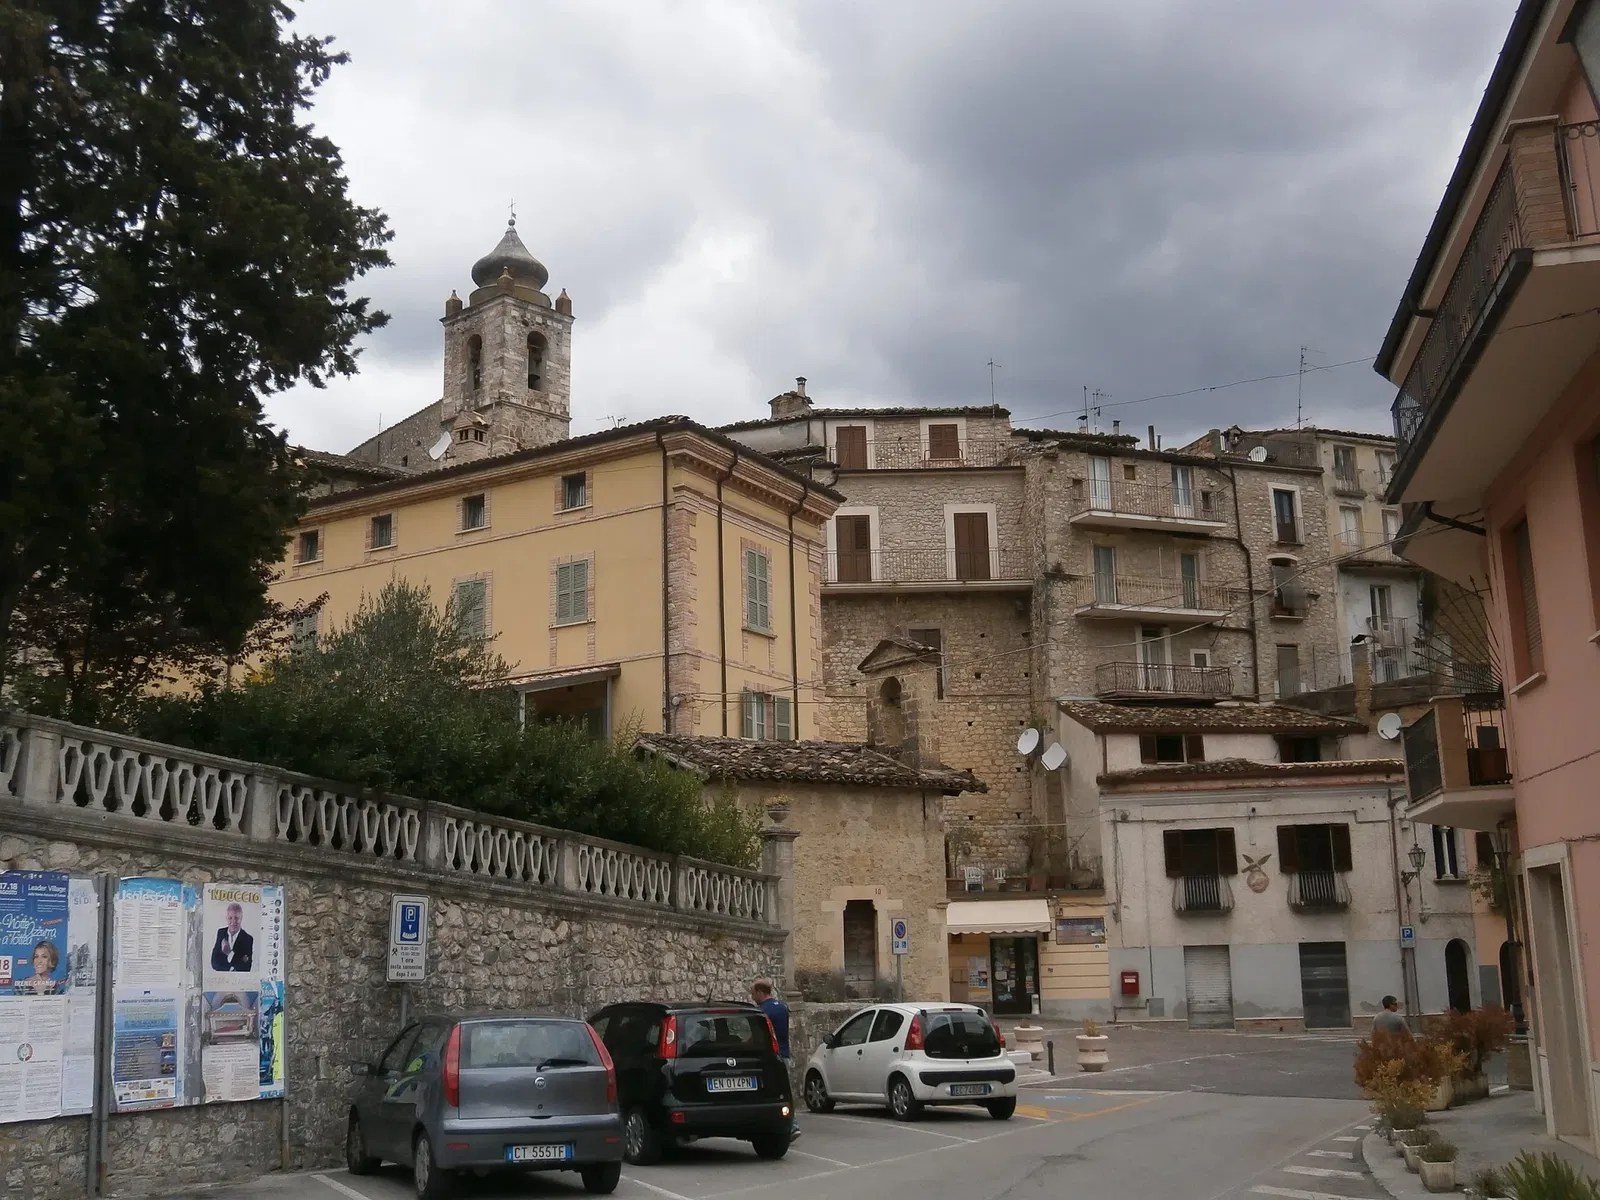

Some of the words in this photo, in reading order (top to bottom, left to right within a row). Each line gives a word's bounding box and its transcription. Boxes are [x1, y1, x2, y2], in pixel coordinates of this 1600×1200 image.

[28, 883, 47, 891] Leader
[48, 885, 67, 893] Village
[713, 1079, 724, 1088] EN
[514, 1147, 528, 1158] CT
[532, 1146, 565, 1158] 555TF
